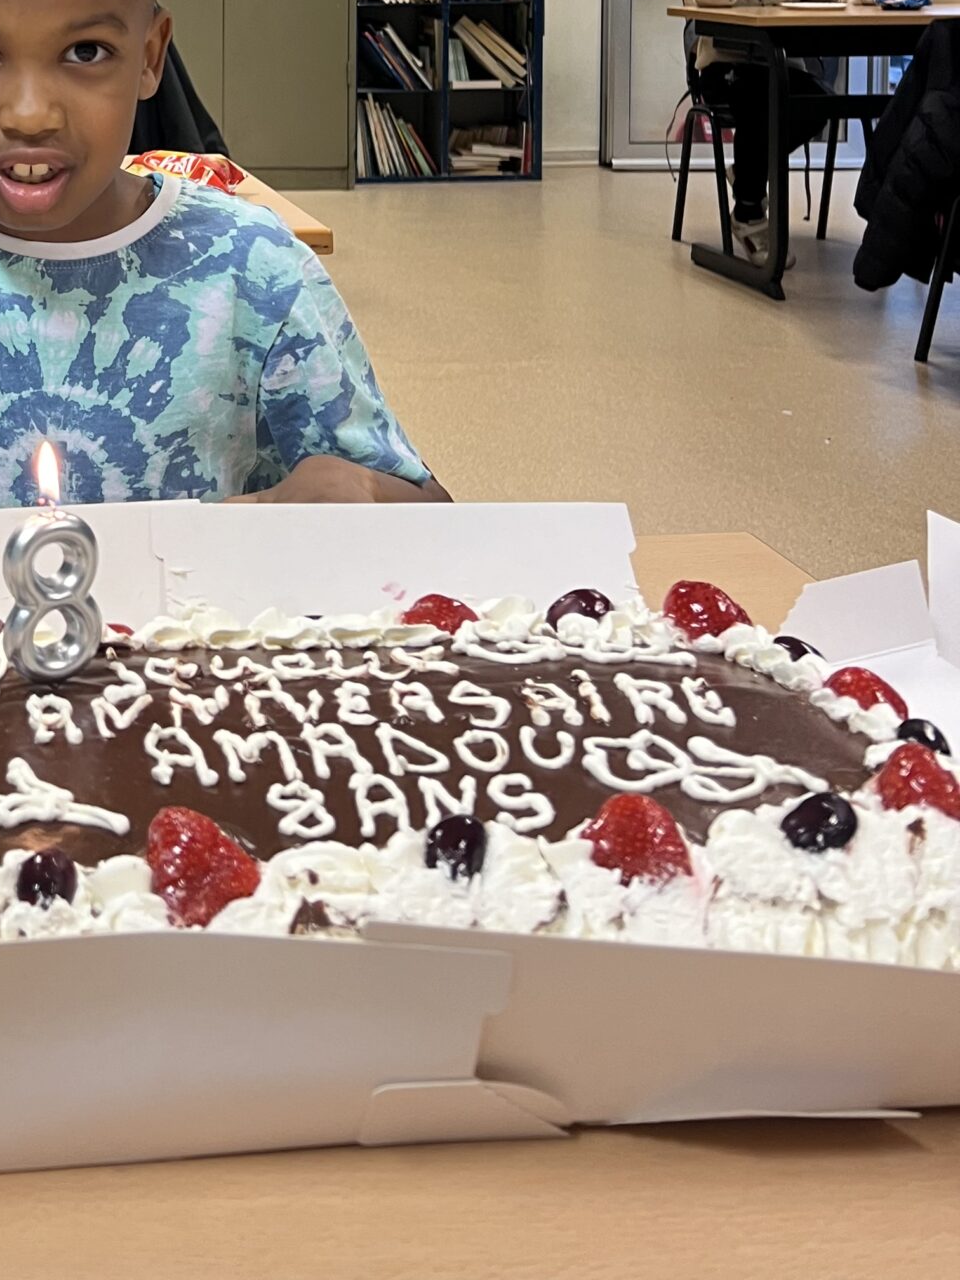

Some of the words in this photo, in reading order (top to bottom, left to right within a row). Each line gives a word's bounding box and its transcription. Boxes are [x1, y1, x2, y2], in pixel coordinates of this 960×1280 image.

[2, 510, 103, 684] 8
[143, 721, 576, 786] AMADOU
[266, 779, 336, 839] 8
[348, 772, 556, 838] ANS
